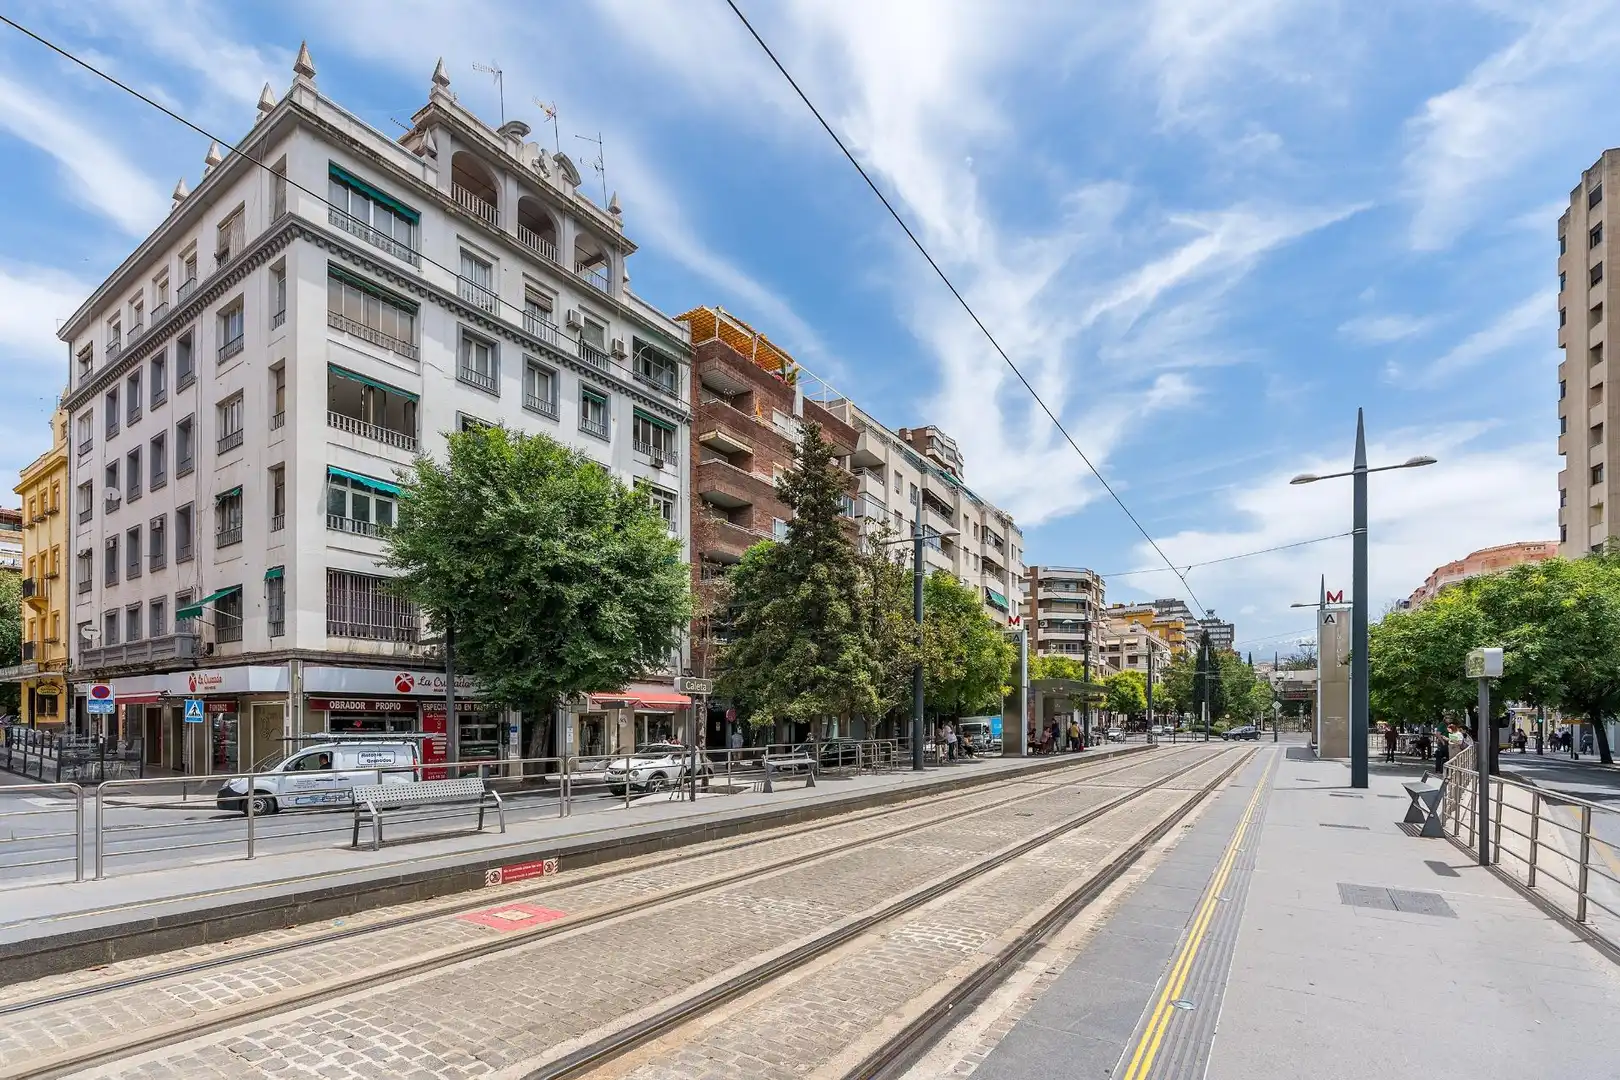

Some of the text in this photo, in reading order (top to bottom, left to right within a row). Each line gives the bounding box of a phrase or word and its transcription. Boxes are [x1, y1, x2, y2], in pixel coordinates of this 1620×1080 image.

[1327, 590, 1343, 604] M
[1008, 615, 1021, 626] M
[418, 675, 471, 688] La Cruada
[685, 680, 707, 691] Caleta
[329, 700, 401, 711] OBRADOR PROPIO
[463, 703, 472, 711] EN
